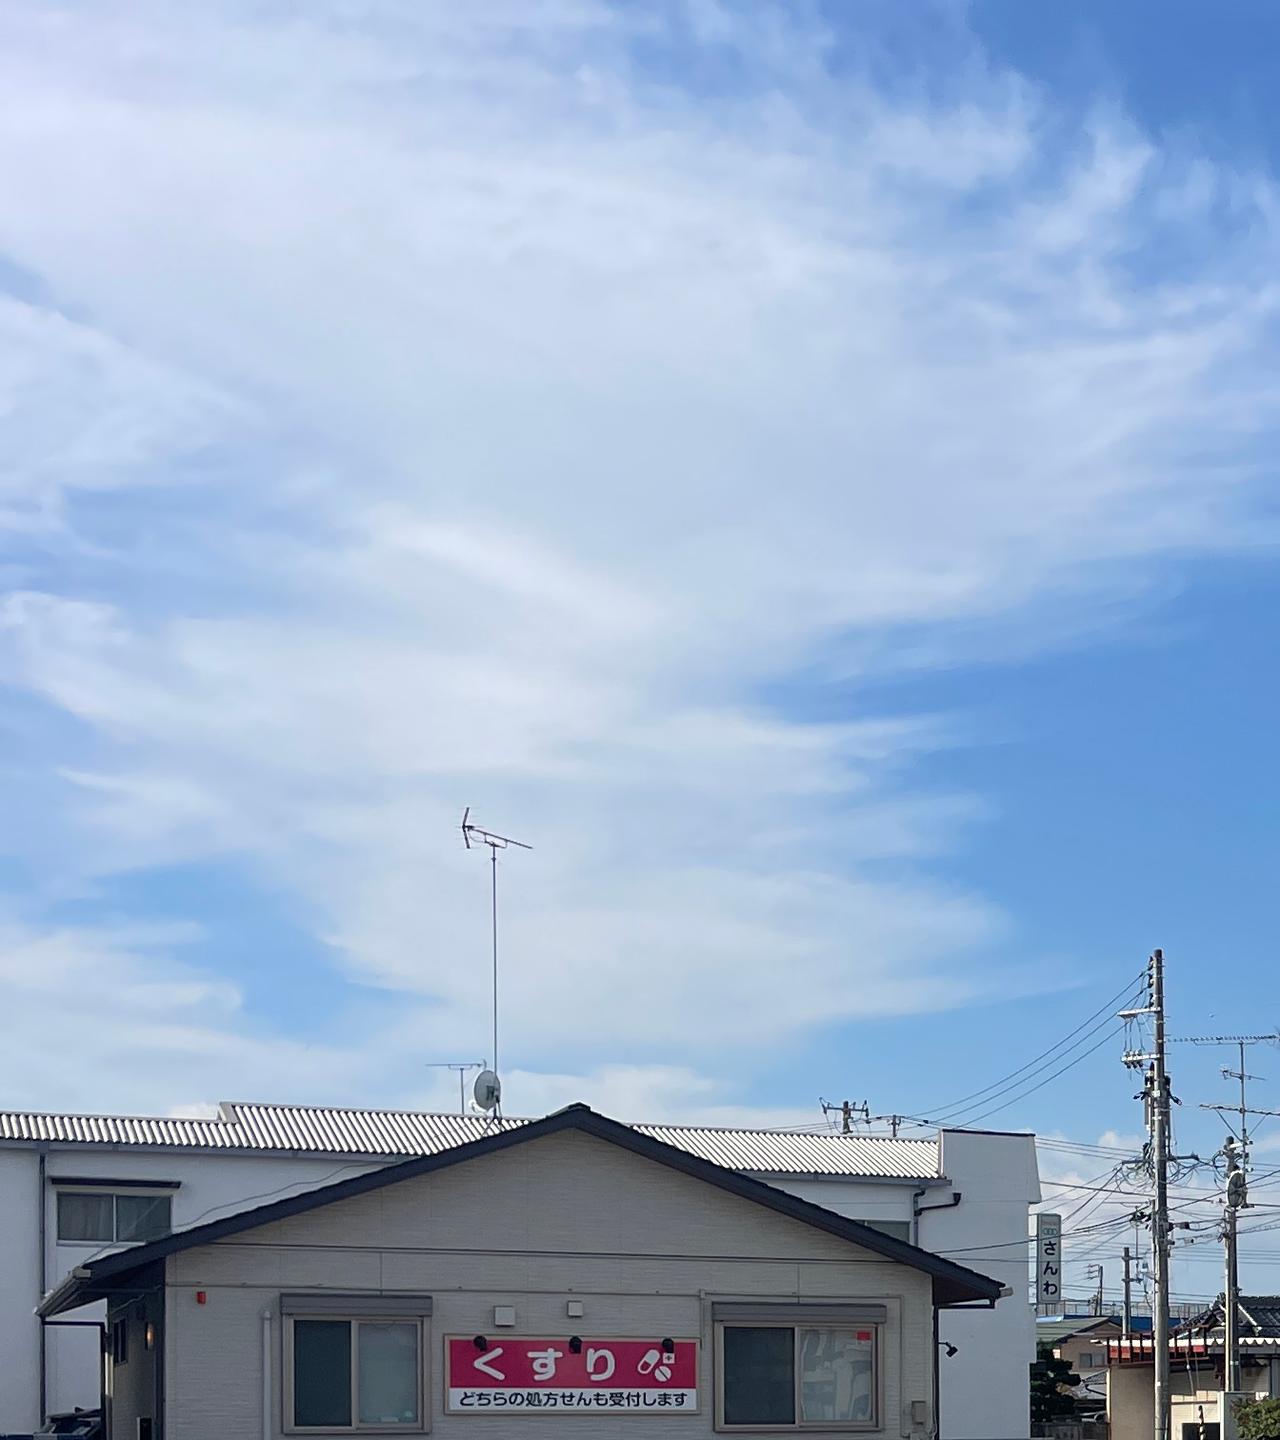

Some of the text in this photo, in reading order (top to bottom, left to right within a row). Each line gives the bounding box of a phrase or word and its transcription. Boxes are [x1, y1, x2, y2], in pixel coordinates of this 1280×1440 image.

[1043, 1240, 1058, 1295] さんわ
[473, 1347, 616, 1381] くすり
[459, 1391, 688, 1408] どちらの処方せんも受付します
